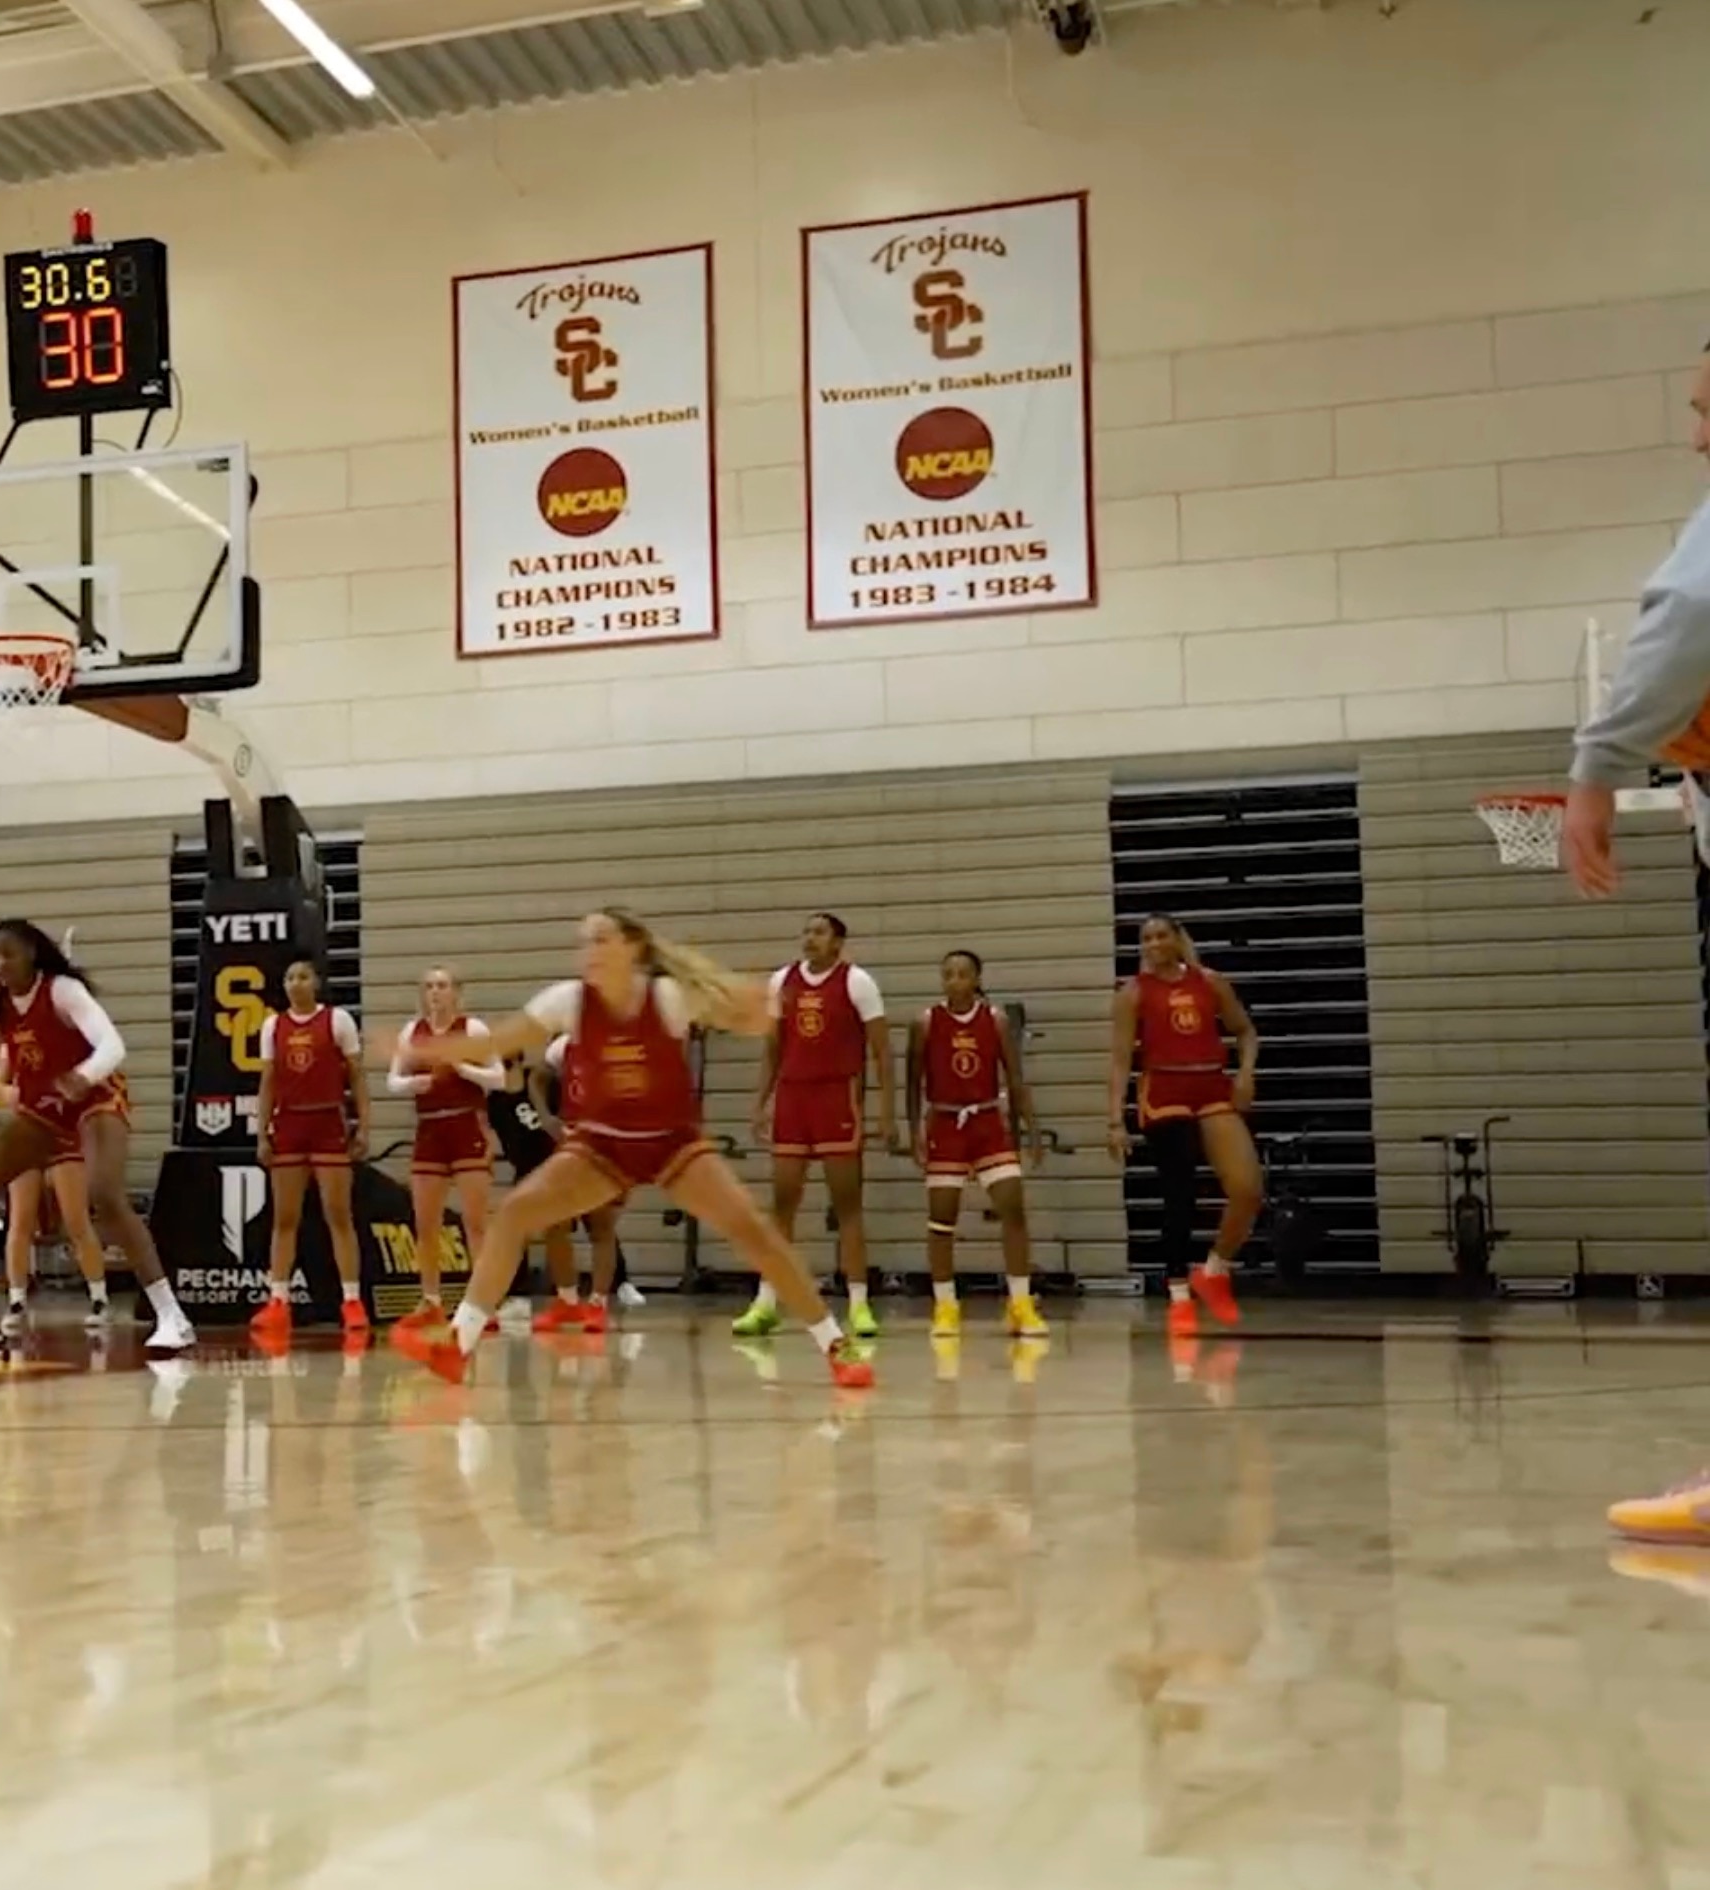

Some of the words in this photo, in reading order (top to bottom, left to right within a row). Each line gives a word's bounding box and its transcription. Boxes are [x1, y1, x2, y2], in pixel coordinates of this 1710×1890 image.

[871, 226, 1008, 274] Trojans
[21, 258, 111, 309] 30.6
[516, 274, 642, 319] Trojans
[912, 269, 984, 360] SC
[42, 307, 124, 388] 30
[554, 315, 618, 402] SC
[819, 379, 932, 404] Women's
[938, 362, 1073, 393] Basketball
[469, 420, 572, 446] Women's
[576, 406, 701, 435] Basketball
[905, 448, 991, 482] NCAA
[547, 486, 626, 519] NCAA
[864, 509, 1033, 543] NATIONAL
[509, 545, 664, 578] NATIONAL
[850, 540, 1048, 576] CHAMPIONS
[496, 575, 677, 610] CHAMPIONS
[206, 912, 288, 943] YETI
[177, 1268, 308, 1289] PECHANA
